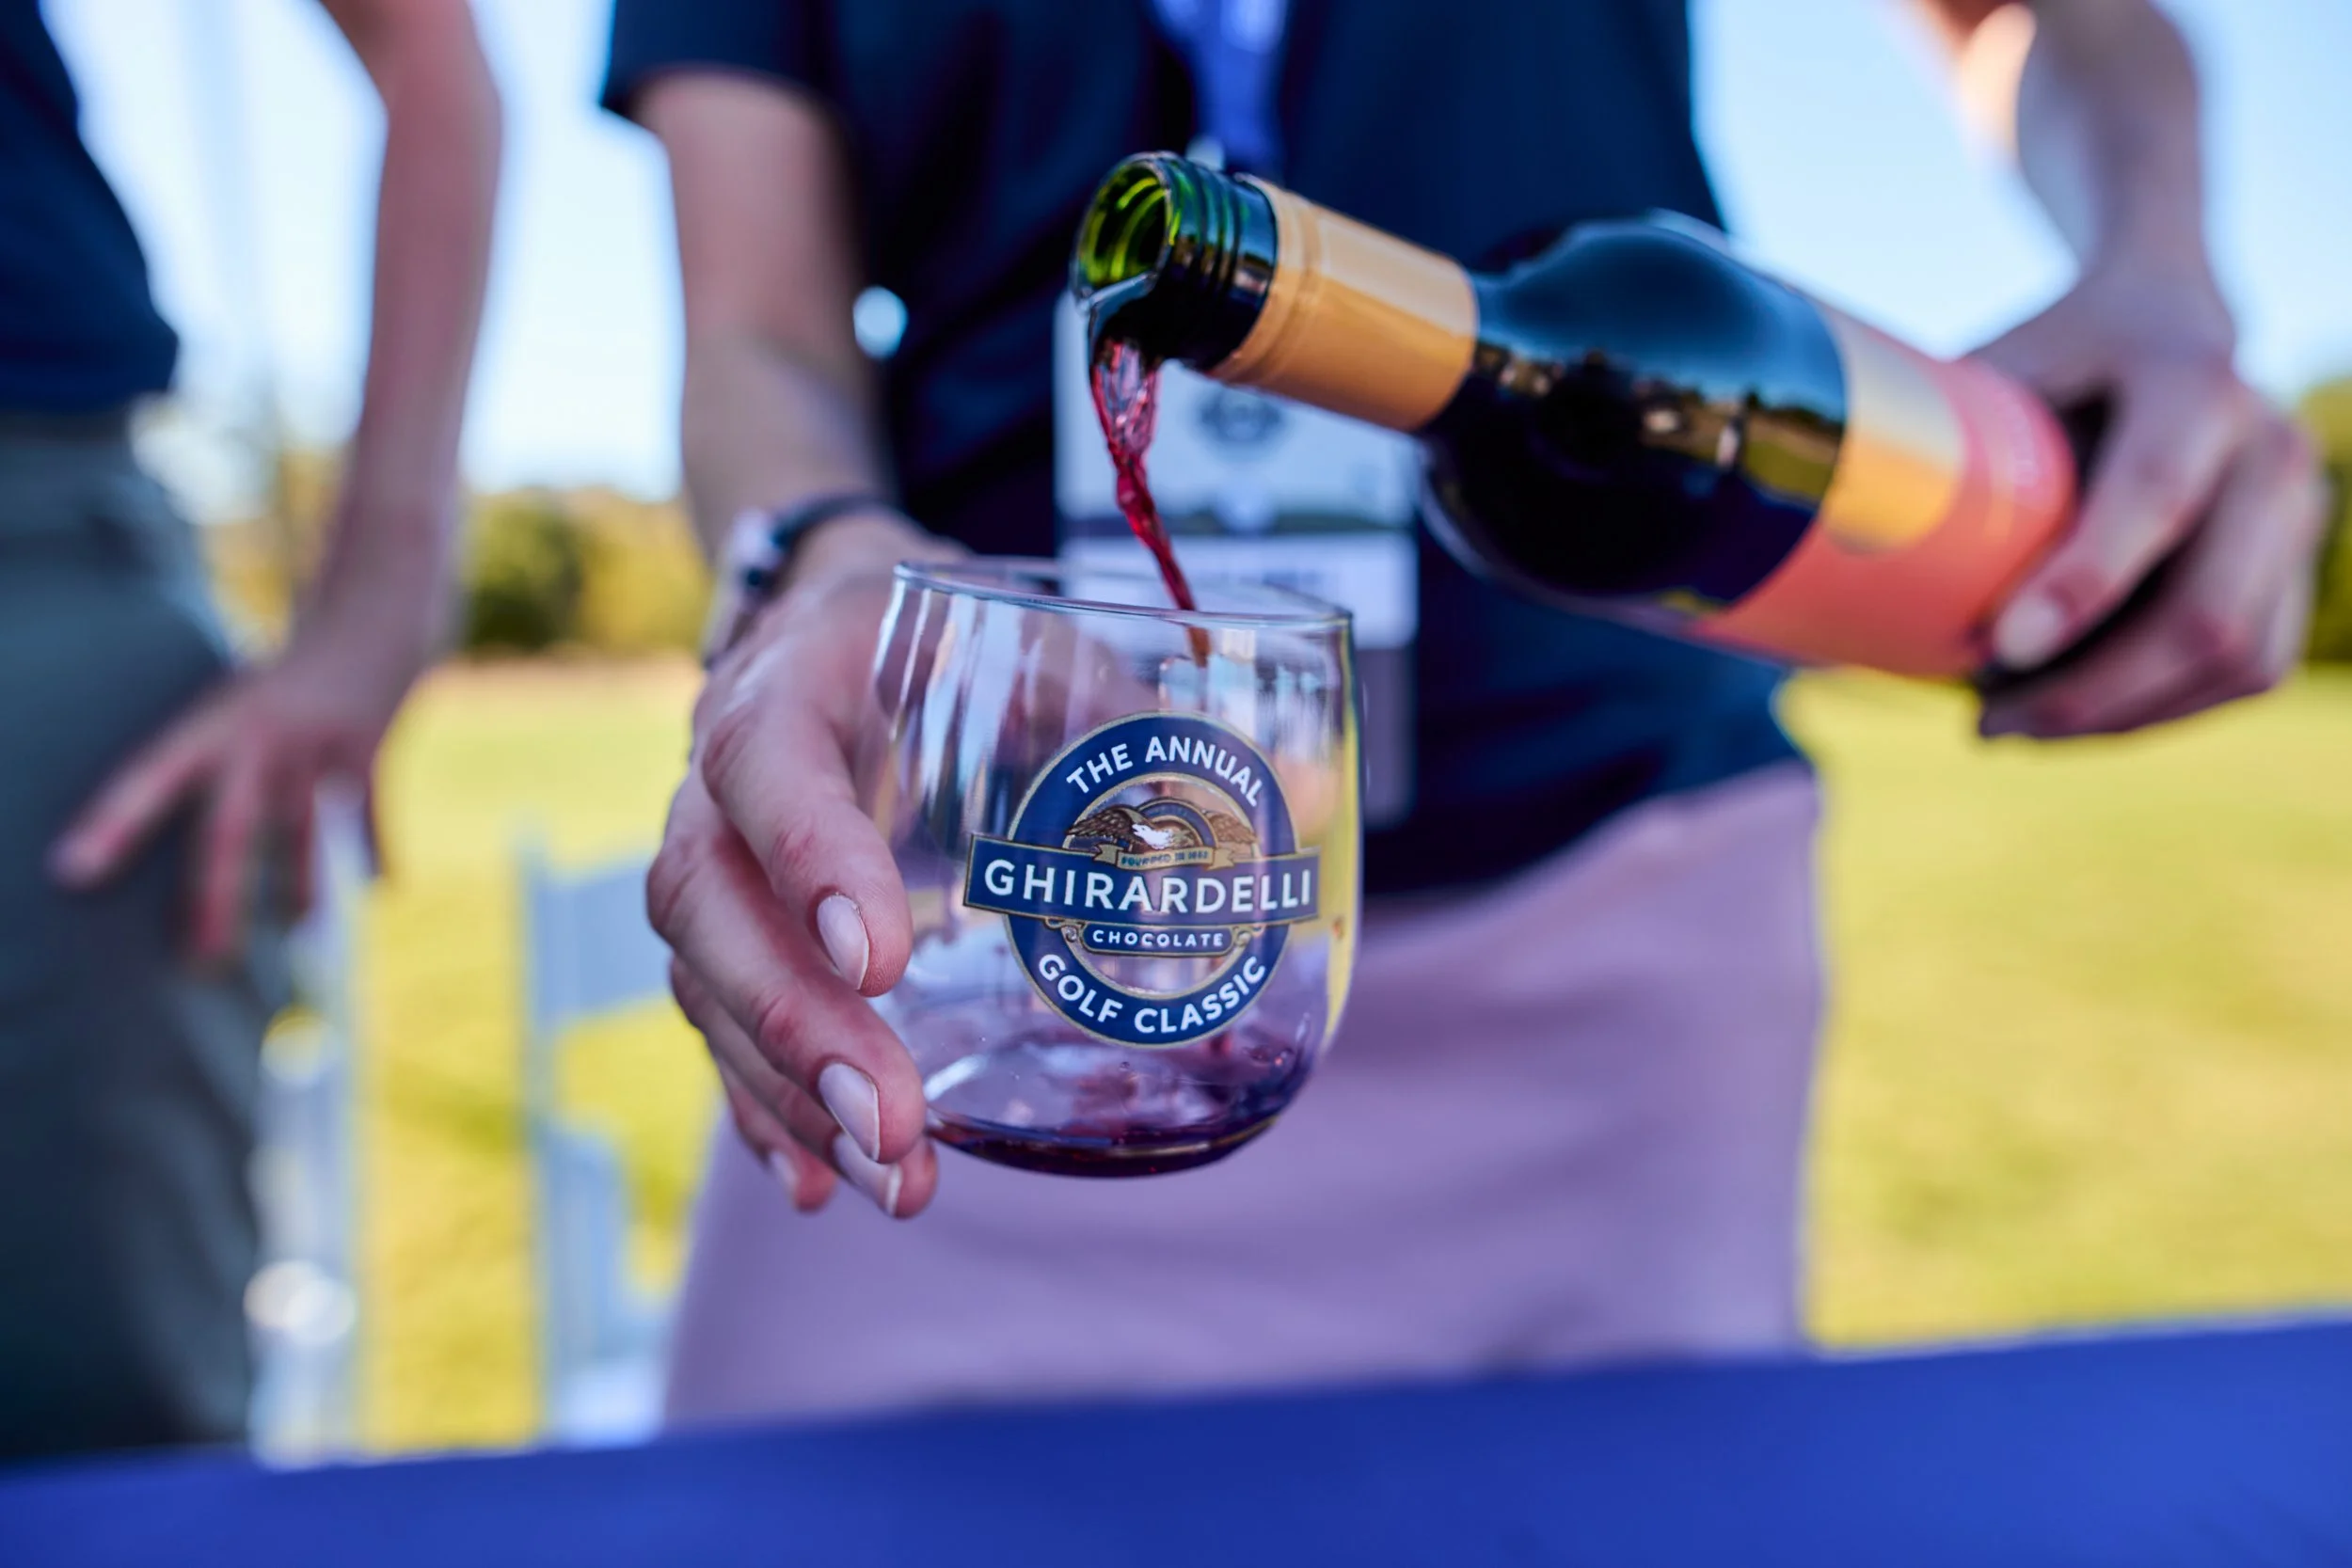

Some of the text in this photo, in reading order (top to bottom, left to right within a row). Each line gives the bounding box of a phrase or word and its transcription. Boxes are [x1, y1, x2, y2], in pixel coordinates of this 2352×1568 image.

[1066, 736, 1263, 807] THE ANNUAL
[984, 859, 1311, 913] GHIRARDELLI
[1092, 929, 1223, 947] CHOCOLATE
[1038, 953, 1266, 1034] GOLF CLASSIC
